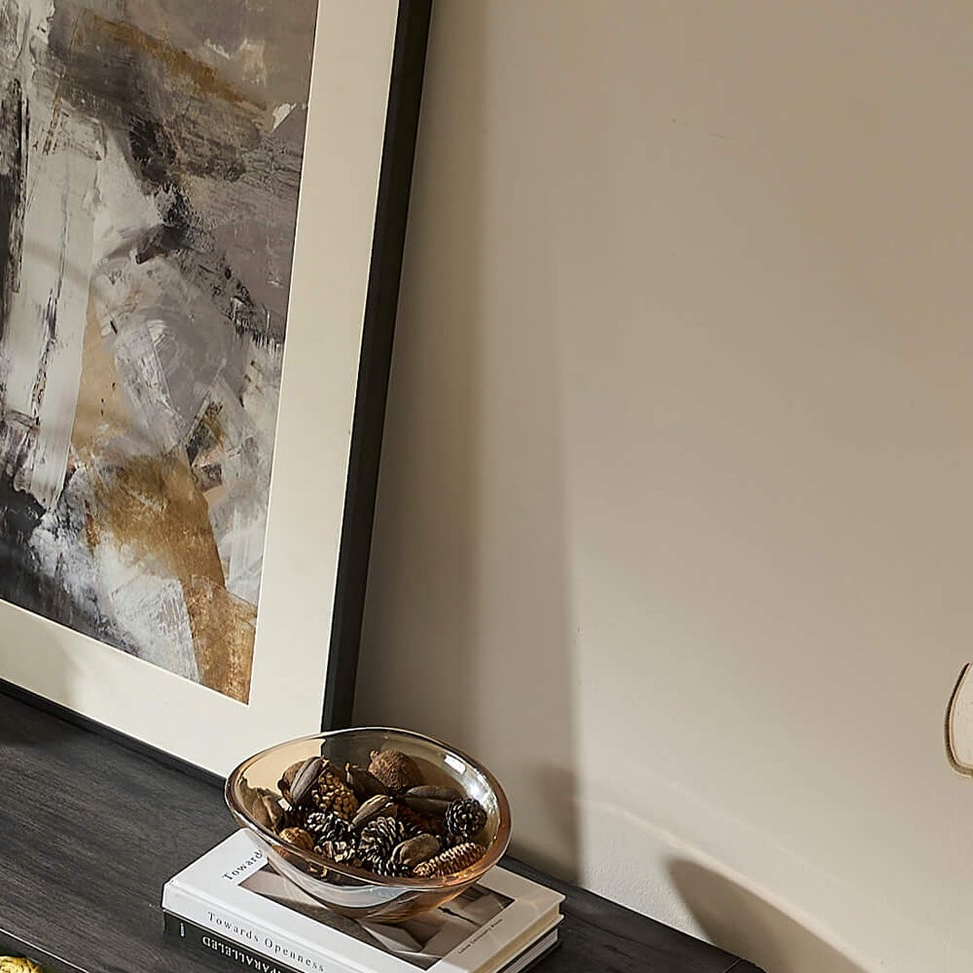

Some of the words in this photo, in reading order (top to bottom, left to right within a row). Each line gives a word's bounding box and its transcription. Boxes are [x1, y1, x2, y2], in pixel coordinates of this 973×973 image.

[221, 849, 264, 881] Toward
[207, 911, 259, 942] Towards
[264, 937, 325, 972] Openness
